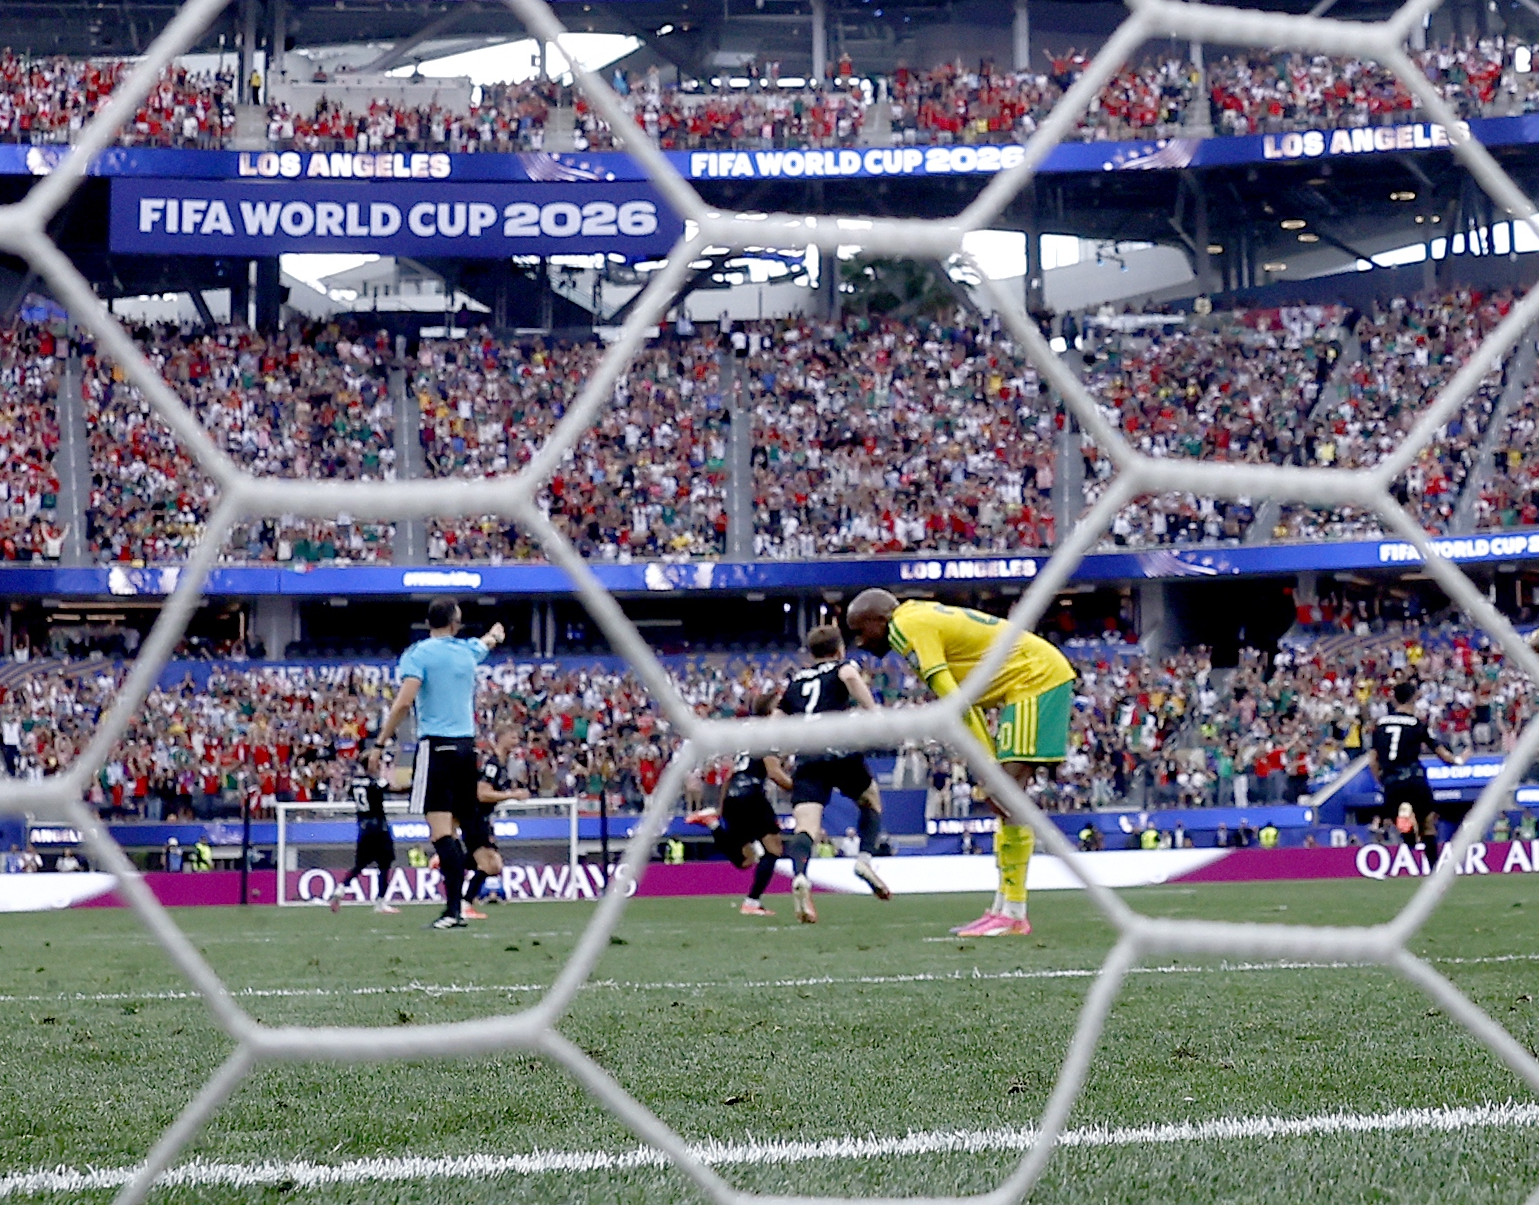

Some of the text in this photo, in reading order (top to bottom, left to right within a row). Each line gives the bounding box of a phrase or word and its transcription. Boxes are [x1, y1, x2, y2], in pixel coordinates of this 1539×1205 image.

[1264, 130, 1325, 159] LOS
[239, 153, 451, 178] LOS ANGELES
[690, 146, 1026, 177] FIFA WORLD CUP 2026
[140, 198, 658, 237] FIFA WORLD CUP 2026
[1379, 541, 1422, 563] FIFA
[1423, 538, 1490, 560] WORLD
[1490, 536, 1528, 557] CUP
[901, 559, 1038, 580] LOS ANGELES
[801, 678, 822, 716] 7
[1385, 725, 1403, 761] 7
